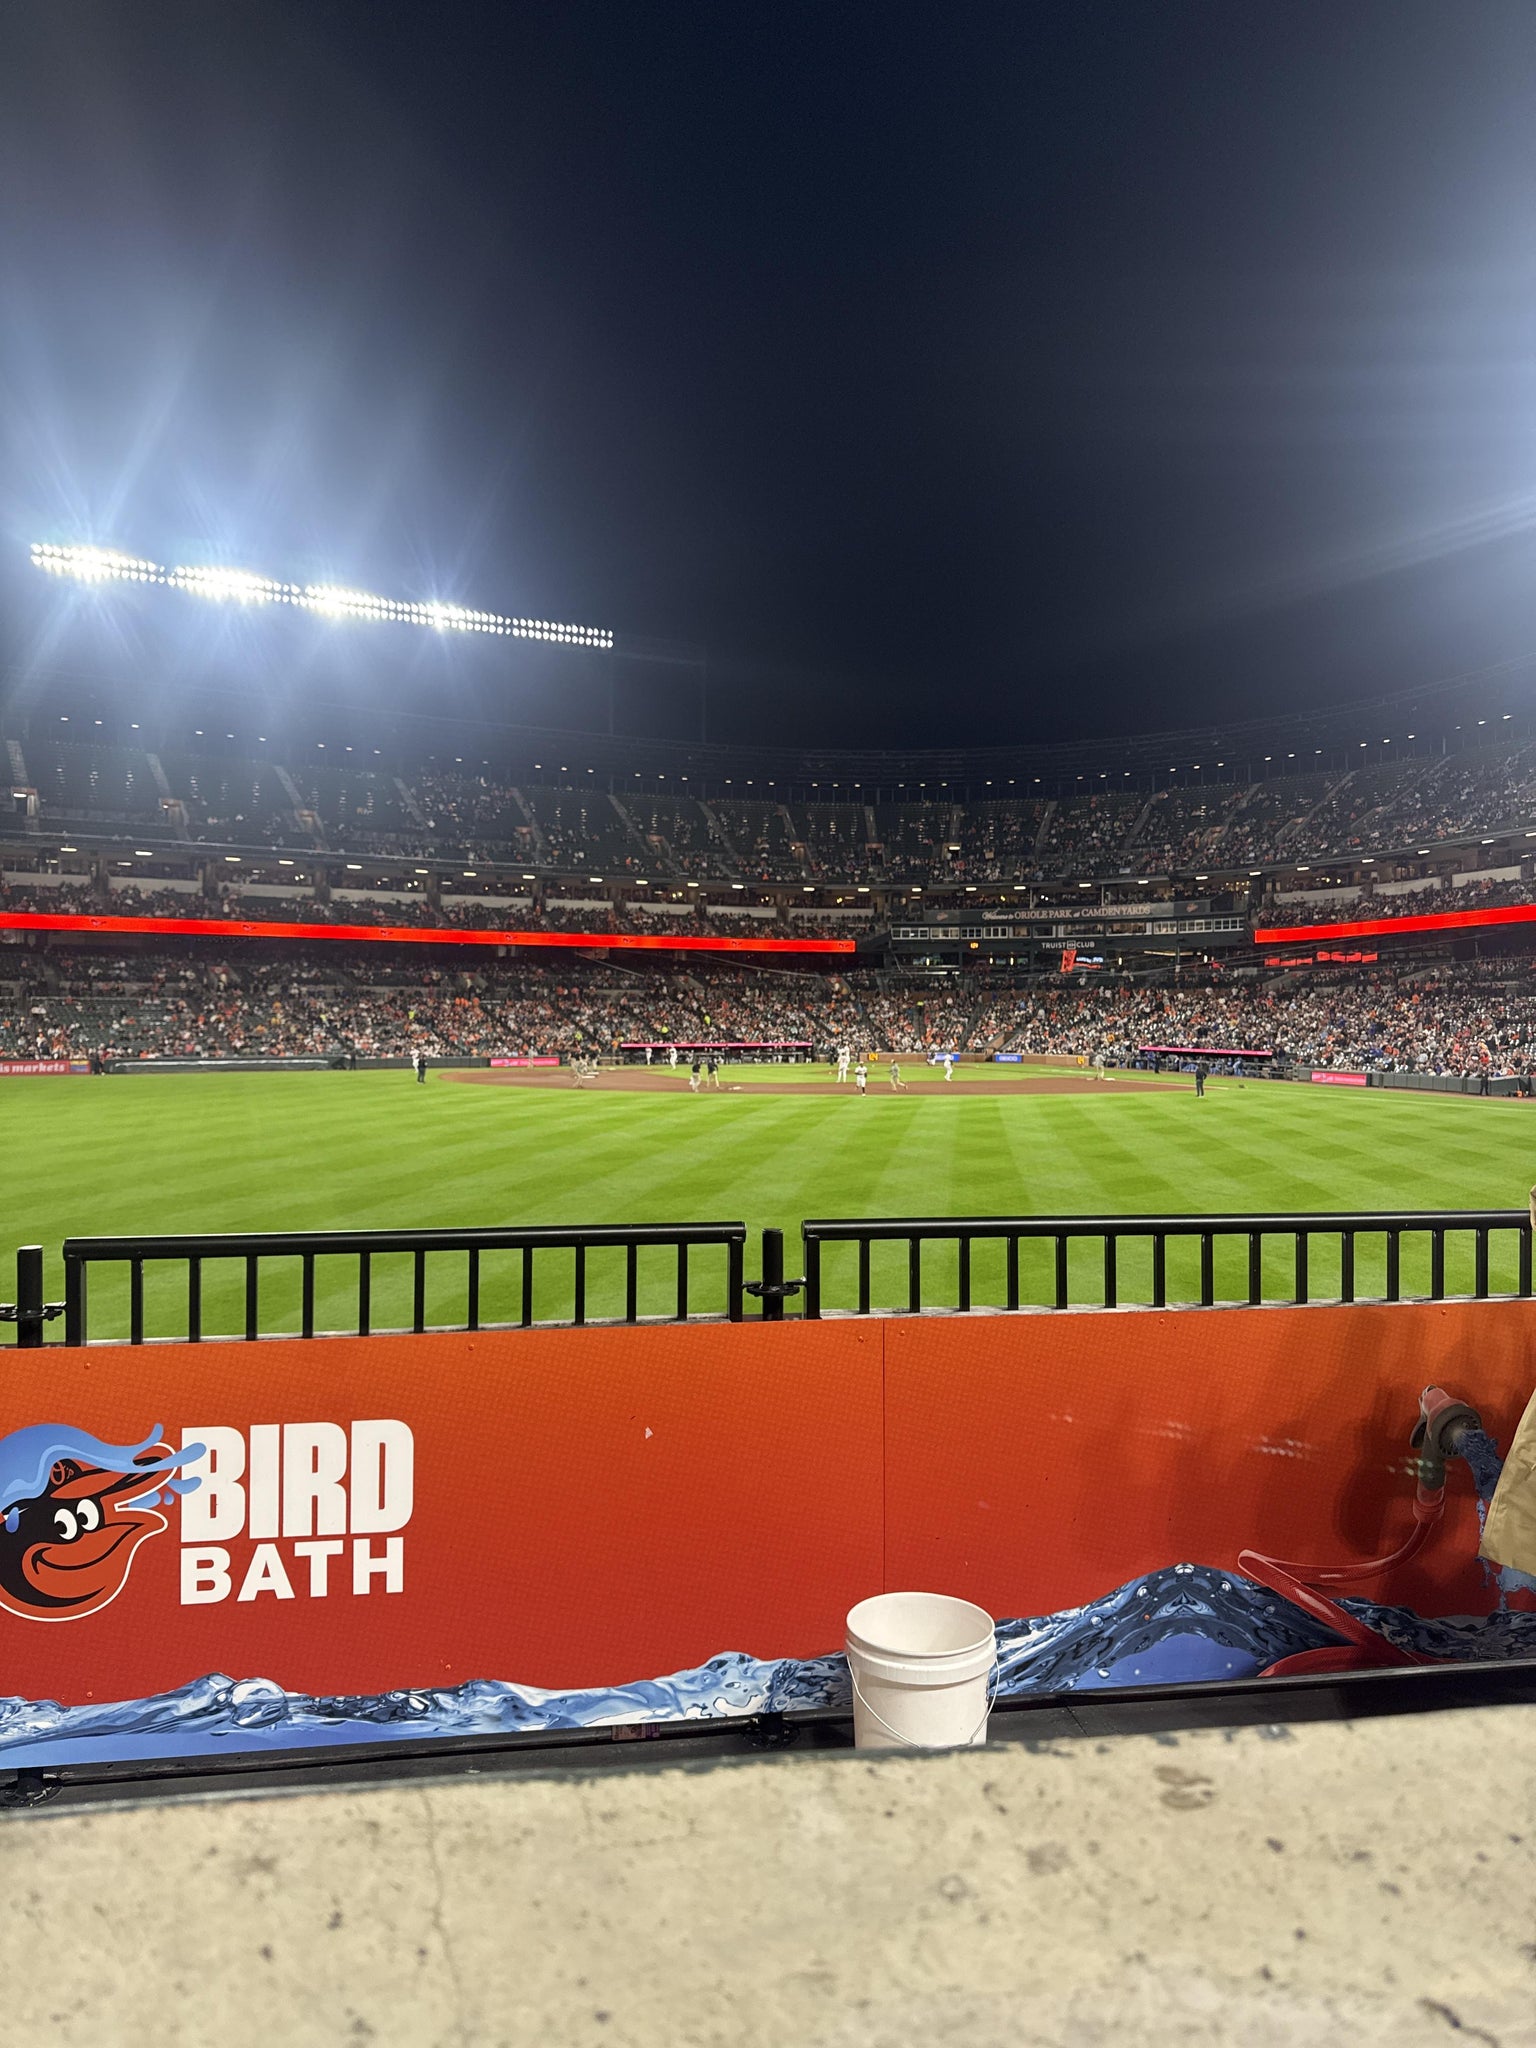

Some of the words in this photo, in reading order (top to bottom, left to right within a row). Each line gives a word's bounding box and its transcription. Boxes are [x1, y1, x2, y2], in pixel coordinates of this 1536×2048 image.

[1014, 910, 1048, 919] ORIOLE
[1048, 909, 1072, 918] PARK
[1081, 907, 1120, 917] CAMDEN
[1120, 905, 1151, 915] YARDS
[1041, 941, 1066, 949] TRUIST
[12, 1062, 65, 1073] markets
[181, 1419, 414, 1543] BIRD
[180, 1537, 404, 1605] BATH
